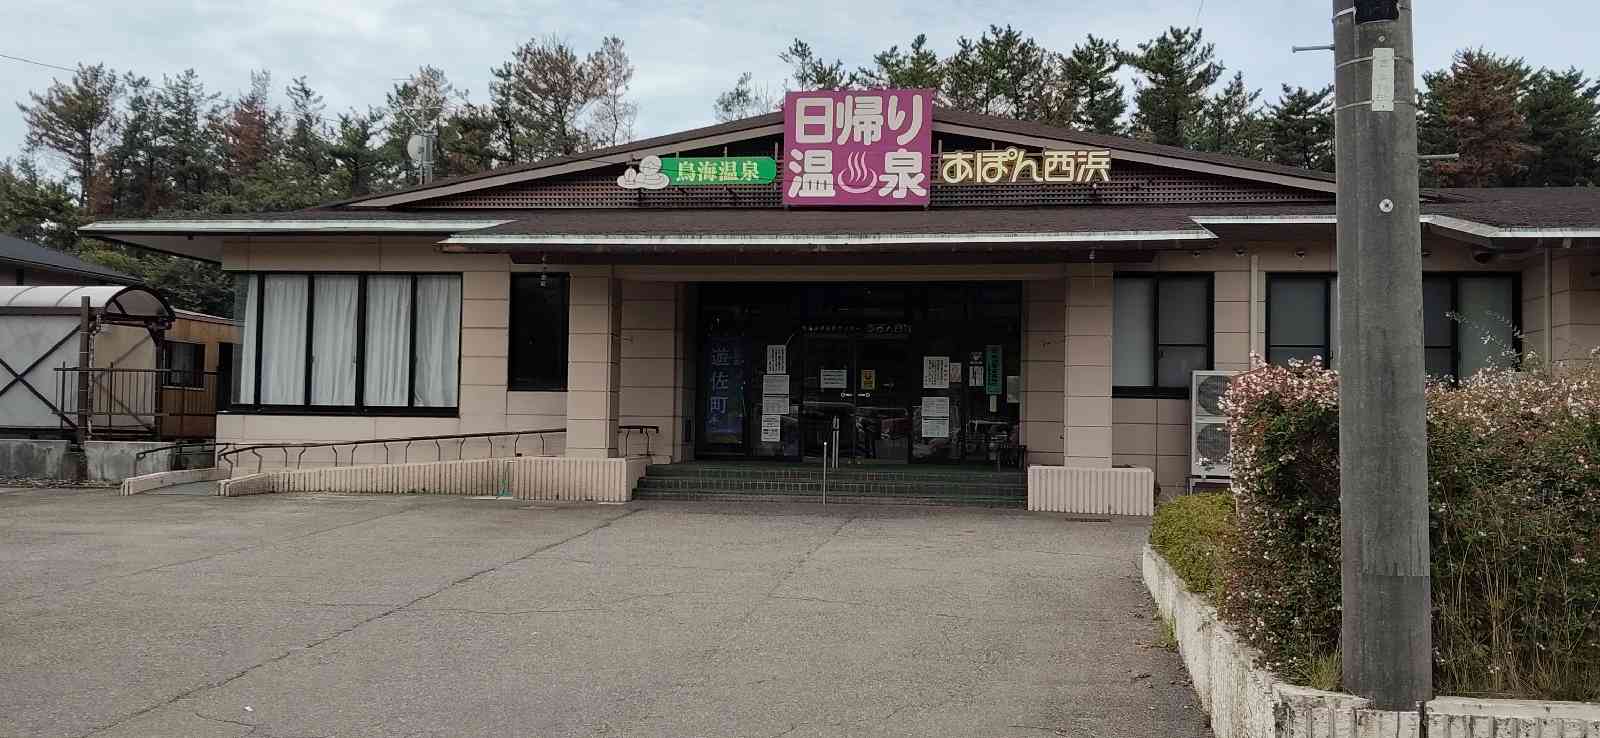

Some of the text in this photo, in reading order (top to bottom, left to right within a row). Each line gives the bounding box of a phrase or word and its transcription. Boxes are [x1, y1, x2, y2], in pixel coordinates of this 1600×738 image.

[795, 94, 923, 146] 日帰り
[676, 161, 759, 182] 鳥海温泉
[942, 148, 1111, 183] あぽん西浜
